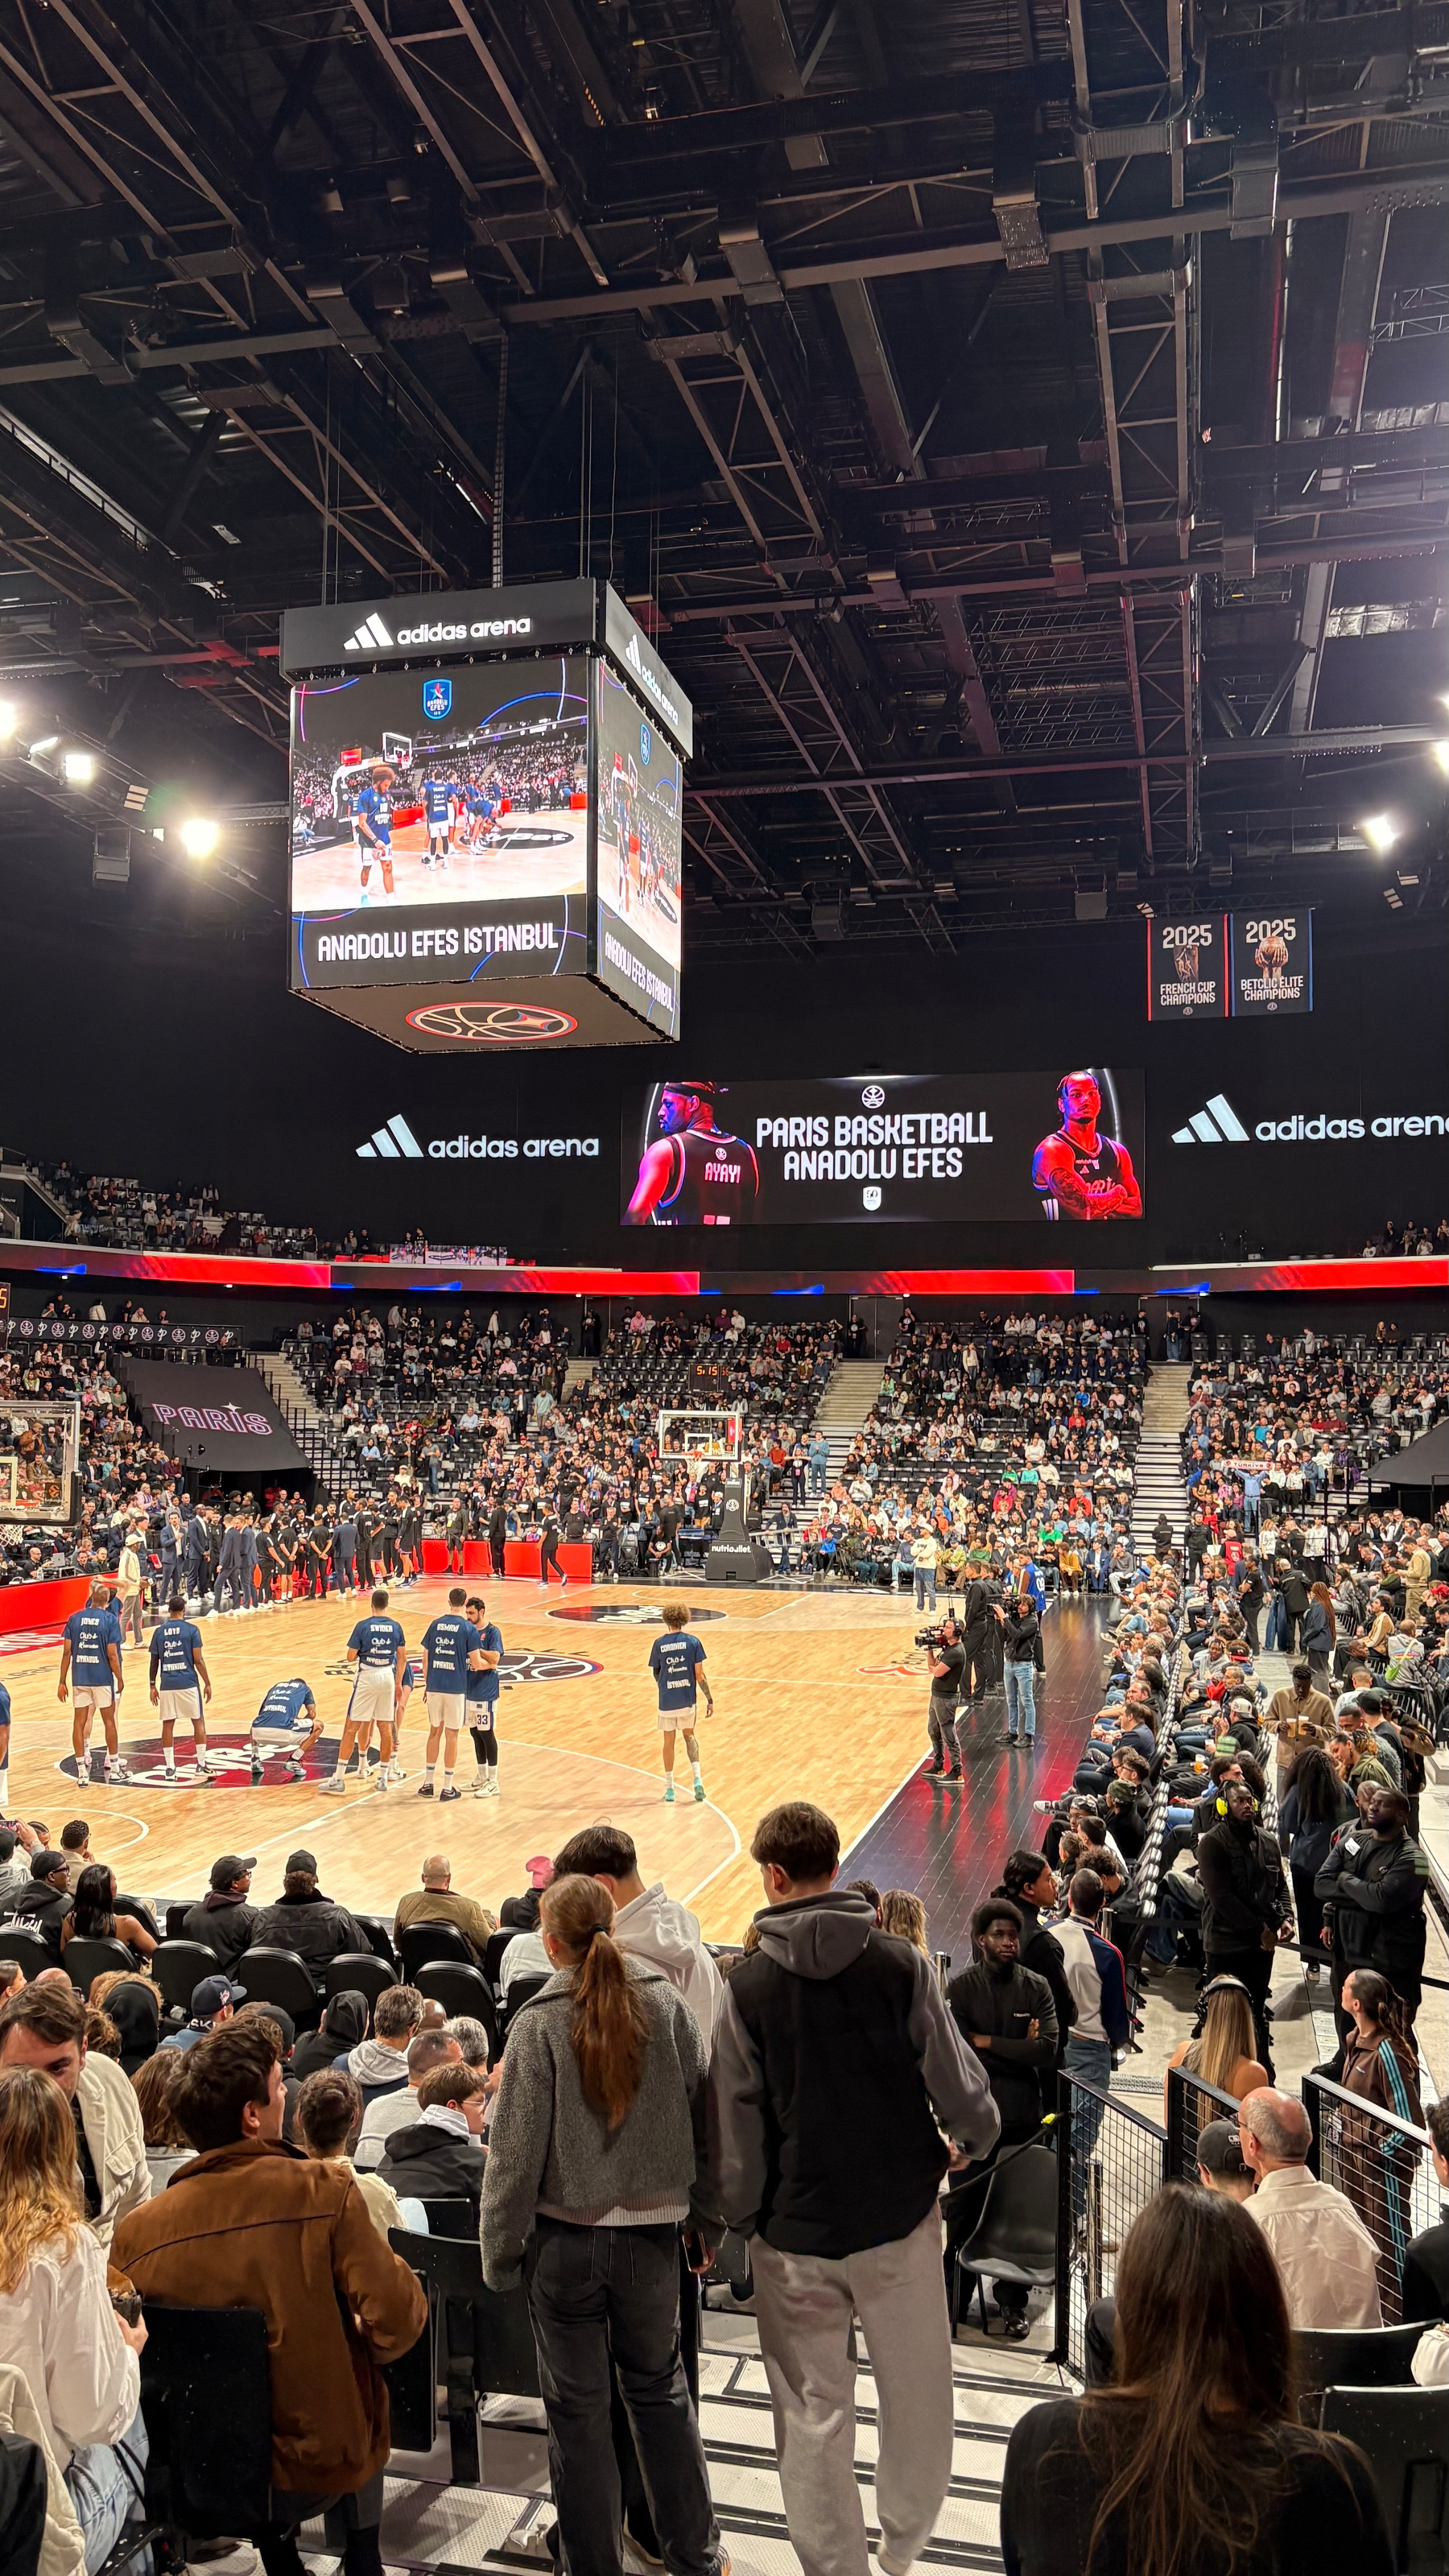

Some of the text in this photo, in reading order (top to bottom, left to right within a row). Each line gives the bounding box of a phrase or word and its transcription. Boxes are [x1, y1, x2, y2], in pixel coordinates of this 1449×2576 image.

[397, 617, 530, 645] adidas arena
[642, 666, 679, 726] adidas arena
[318, 923, 559, 961] ANADOLU EFES ISTANBUL
[1162, 924, 1212, 949] 2025
[1245, 918, 1297, 943] 2025
[605, 931, 673, 1012] ANADOLU EFES ISTANBUL
[1241, 978, 1278, 990] BETCLIC
[1160, 980, 1216, 995] FRENCH CUP
[1160, 992, 1216, 1005] CHAMPIONS
[1244, 988, 1300, 1001] CHAMPIONS
[756, 1112, 993, 1148] PARIS BASKETBALL
[1255, 1114, 1449, 1141] adidas aren
[427, 1135, 599, 1158] adidas arena
[704, 1162, 741, 1183] AYAYI
[783, 1147, 963, 1181] ANADOLU EFES
[151, 1402, 273, 1435] PARIS
[80, 1617, 100, 1626] JONES
[477, 1715, 488, 1725] 33
